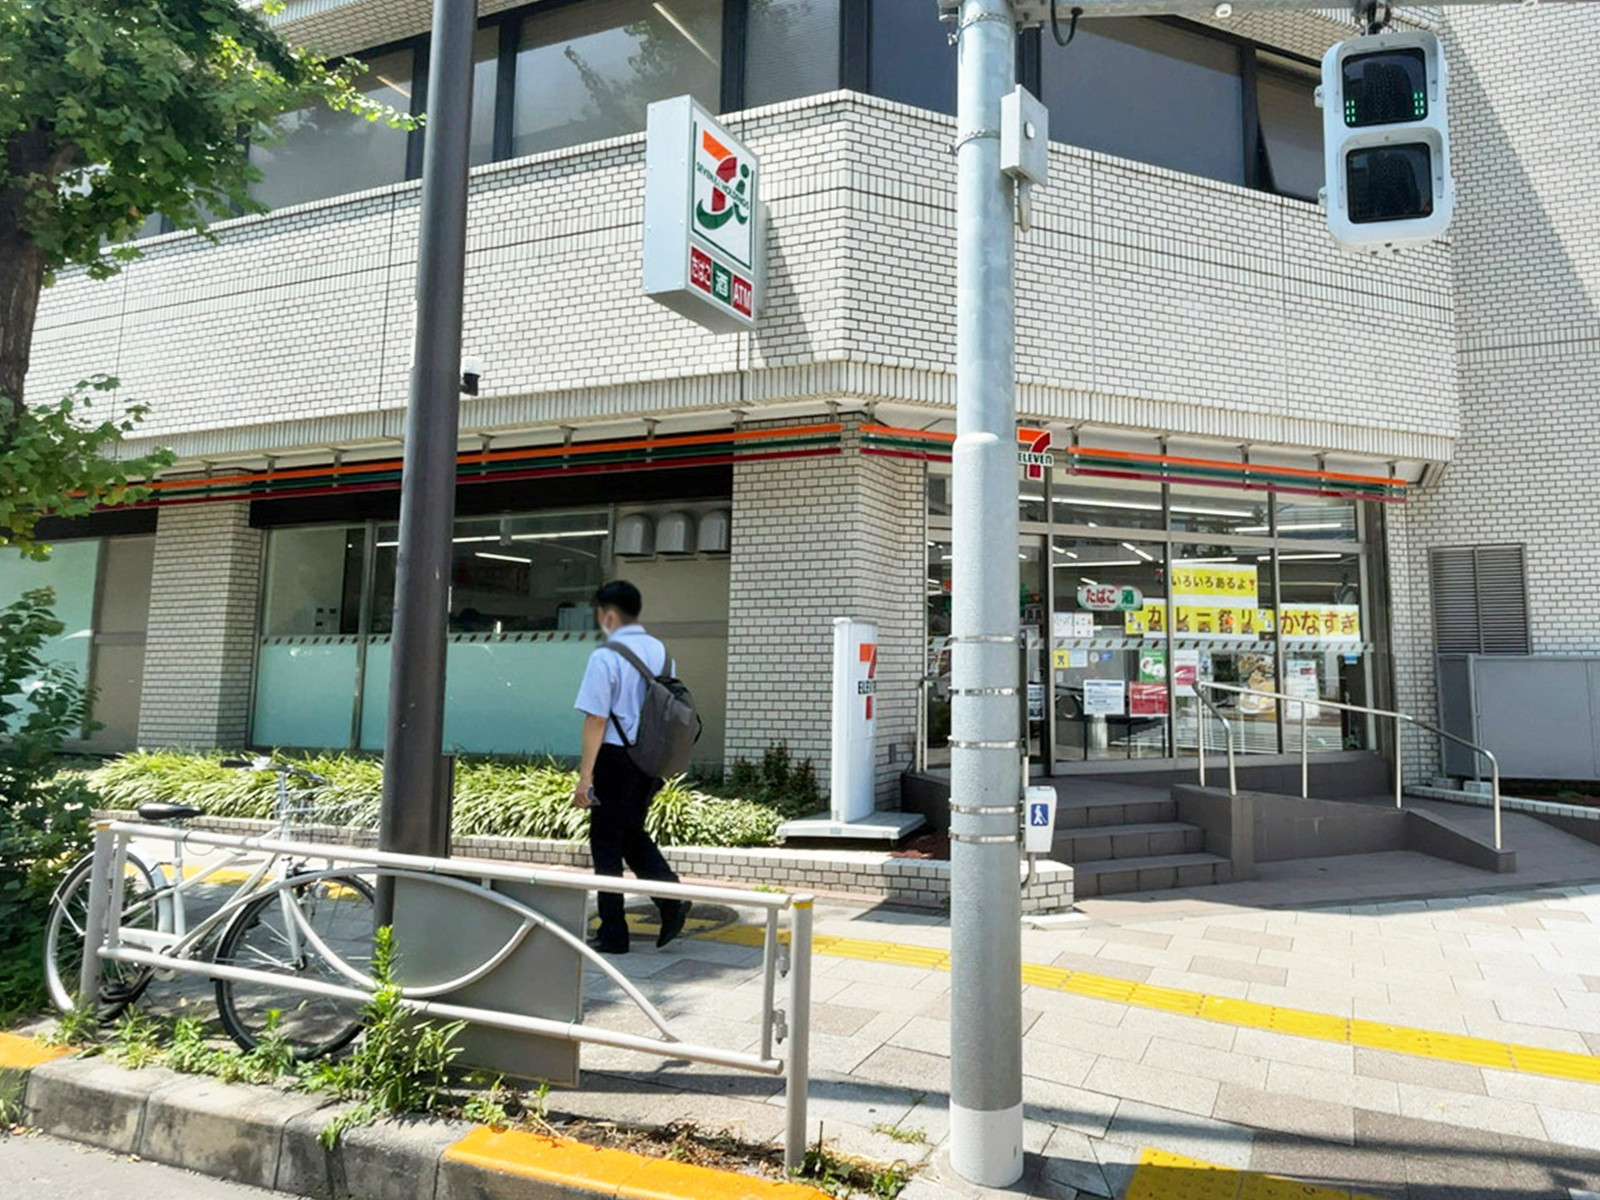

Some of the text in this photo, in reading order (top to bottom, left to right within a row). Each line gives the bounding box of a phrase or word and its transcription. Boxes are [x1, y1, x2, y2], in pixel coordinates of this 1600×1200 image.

[691, 255, 711, 286] たばこ
[715, 269, 729, 297] 酒
[733, 282, 752, 308] ATM
[1085, 588, 1116, 604] たばこ
[1121, 589, 1135, 605] 酒
